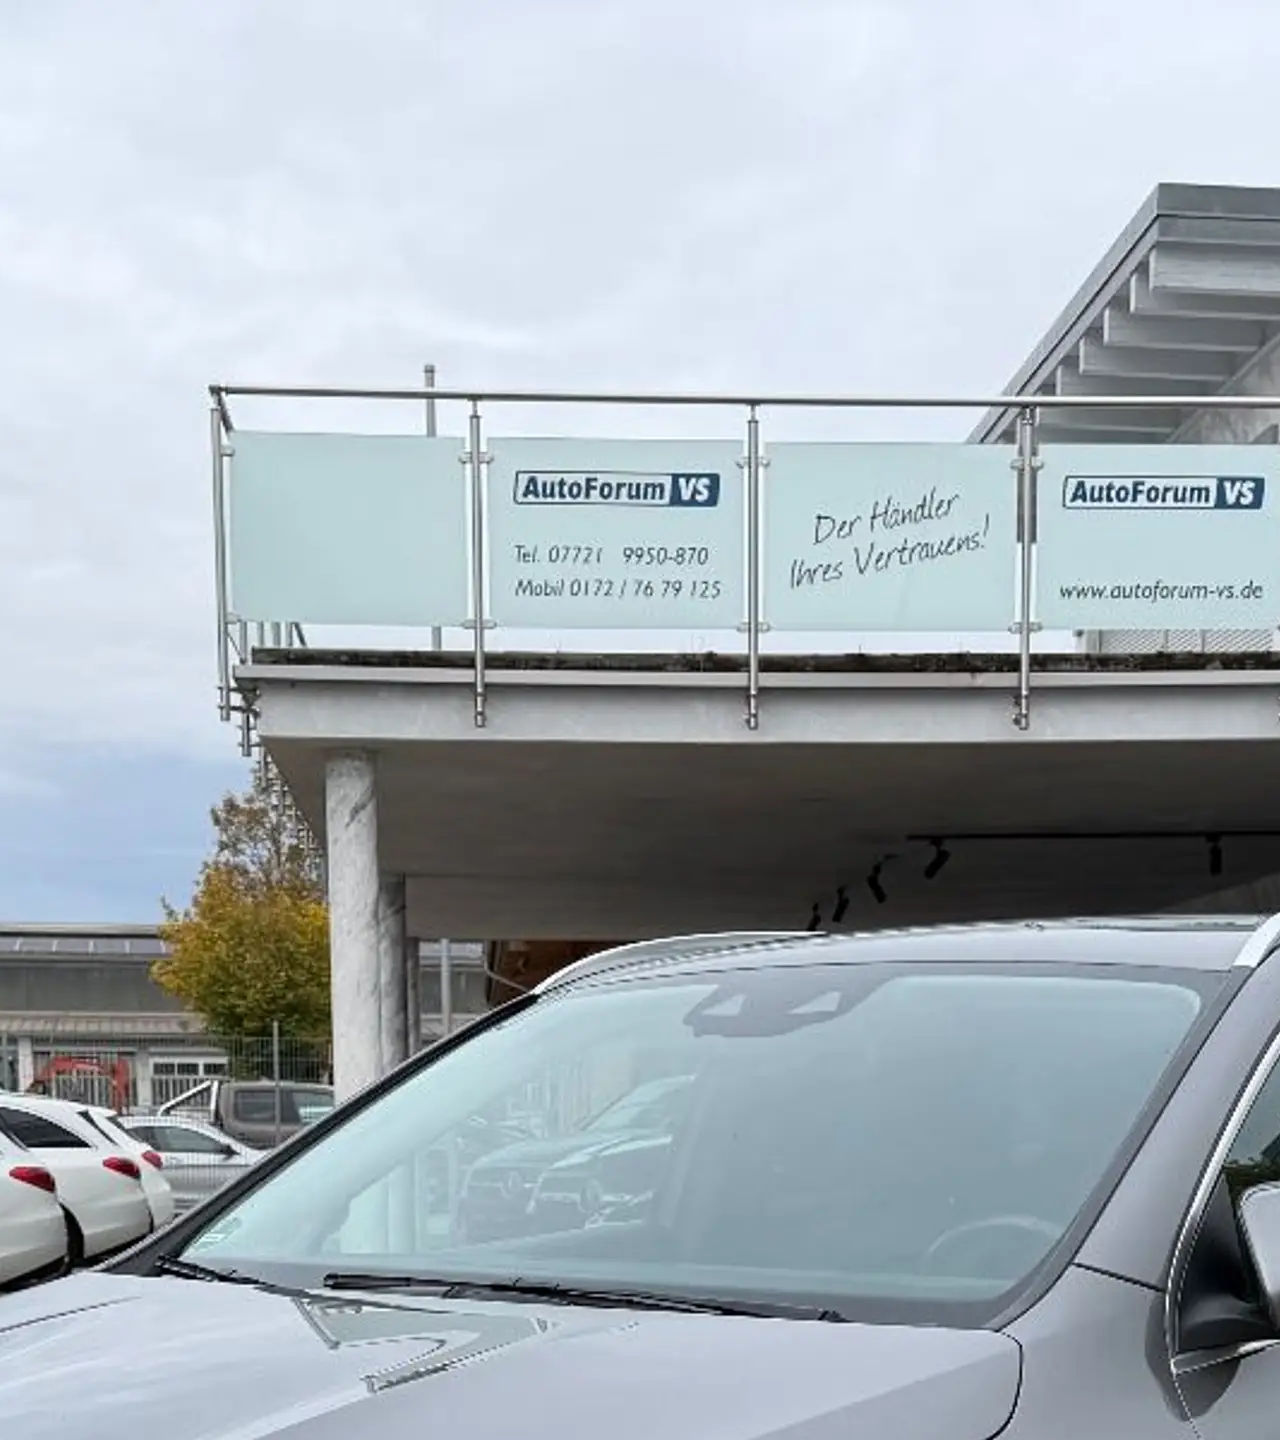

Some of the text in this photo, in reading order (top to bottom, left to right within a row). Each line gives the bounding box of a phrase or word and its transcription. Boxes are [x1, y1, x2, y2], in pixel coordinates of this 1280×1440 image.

[522, 475, 712, 502] AutoForum VS
[1070, 480, 1257, 505] AutoForum VS
[813, 486, 960, 545] Der Händler
[515, 544, 710, 566] Tel. 07721 9950-870
[790, 513, 990, 589] Ihres Vertrauens!
[515, 577, 565, 597] Mobil
[570, 579, 614, 597] 0172
[1060, 578, 1264, 603] www.autoforum-vs.de
